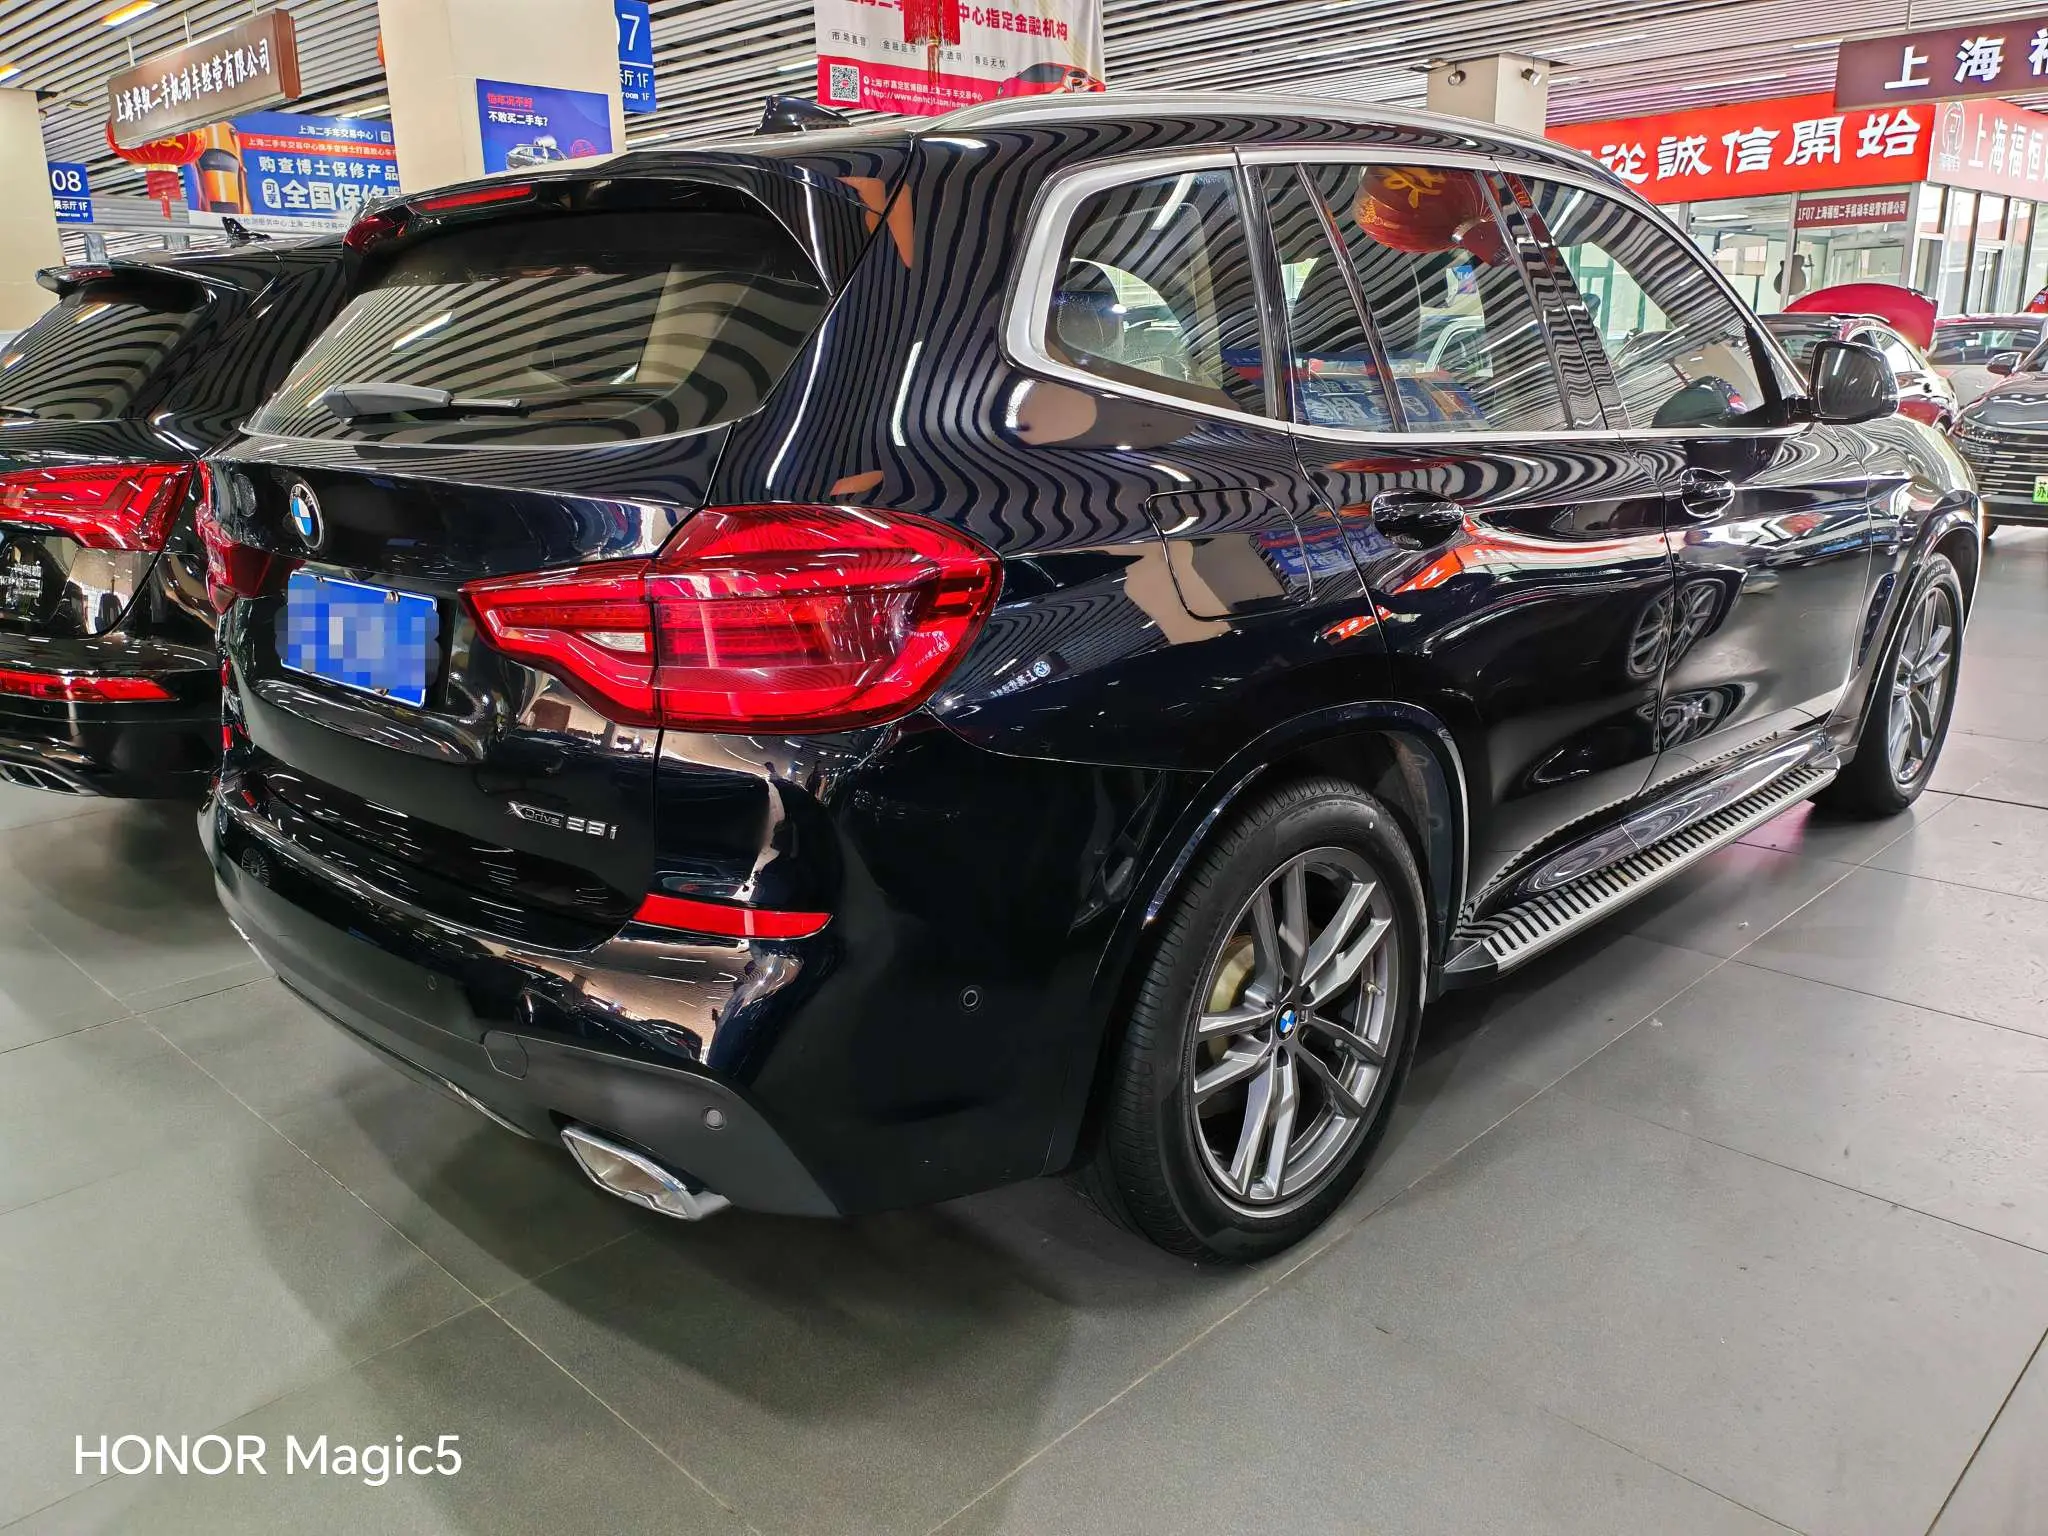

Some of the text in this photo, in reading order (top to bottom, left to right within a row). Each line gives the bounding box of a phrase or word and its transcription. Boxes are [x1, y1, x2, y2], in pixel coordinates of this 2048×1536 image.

[616, 13, 640, 51] 7
[958, 2, 1068, 41] 中心指定金融机构
[637, 72, 649, 89] 1F
[298, 125, 374, 140] 上海二手车交易中心
[1580, 108, 1920, 185] 從誠信開始
[1967, 112, 2048, 184] 上海福恒
[52, 169, 82, 191] 08
[258, 156, 399, 181] 购查博士保修产品
[78, 201, 88, 211] 1F
[1798, 206, 1815, 221] 1F07
